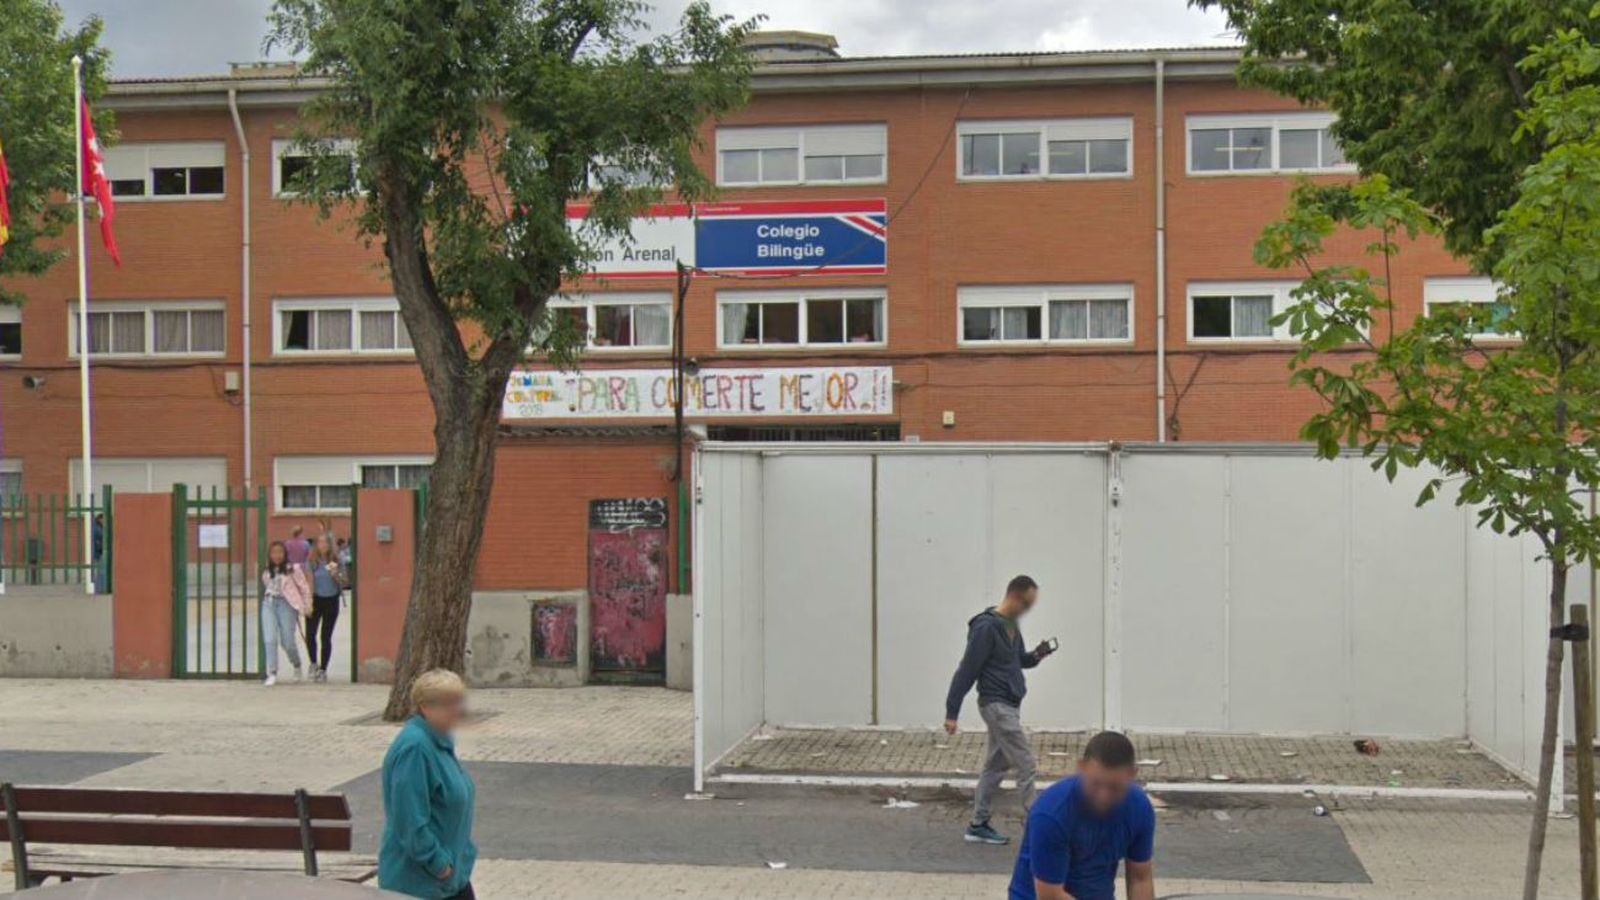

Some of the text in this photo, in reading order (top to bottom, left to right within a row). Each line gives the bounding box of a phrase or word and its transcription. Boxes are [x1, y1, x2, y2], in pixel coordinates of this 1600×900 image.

[756, 224, 820, 240] Colegio
[622, 246, 676, 262] Arenal
[757, 243, 825, 260] Bilingüe
[651, 374, 765, 411] COMERTE
